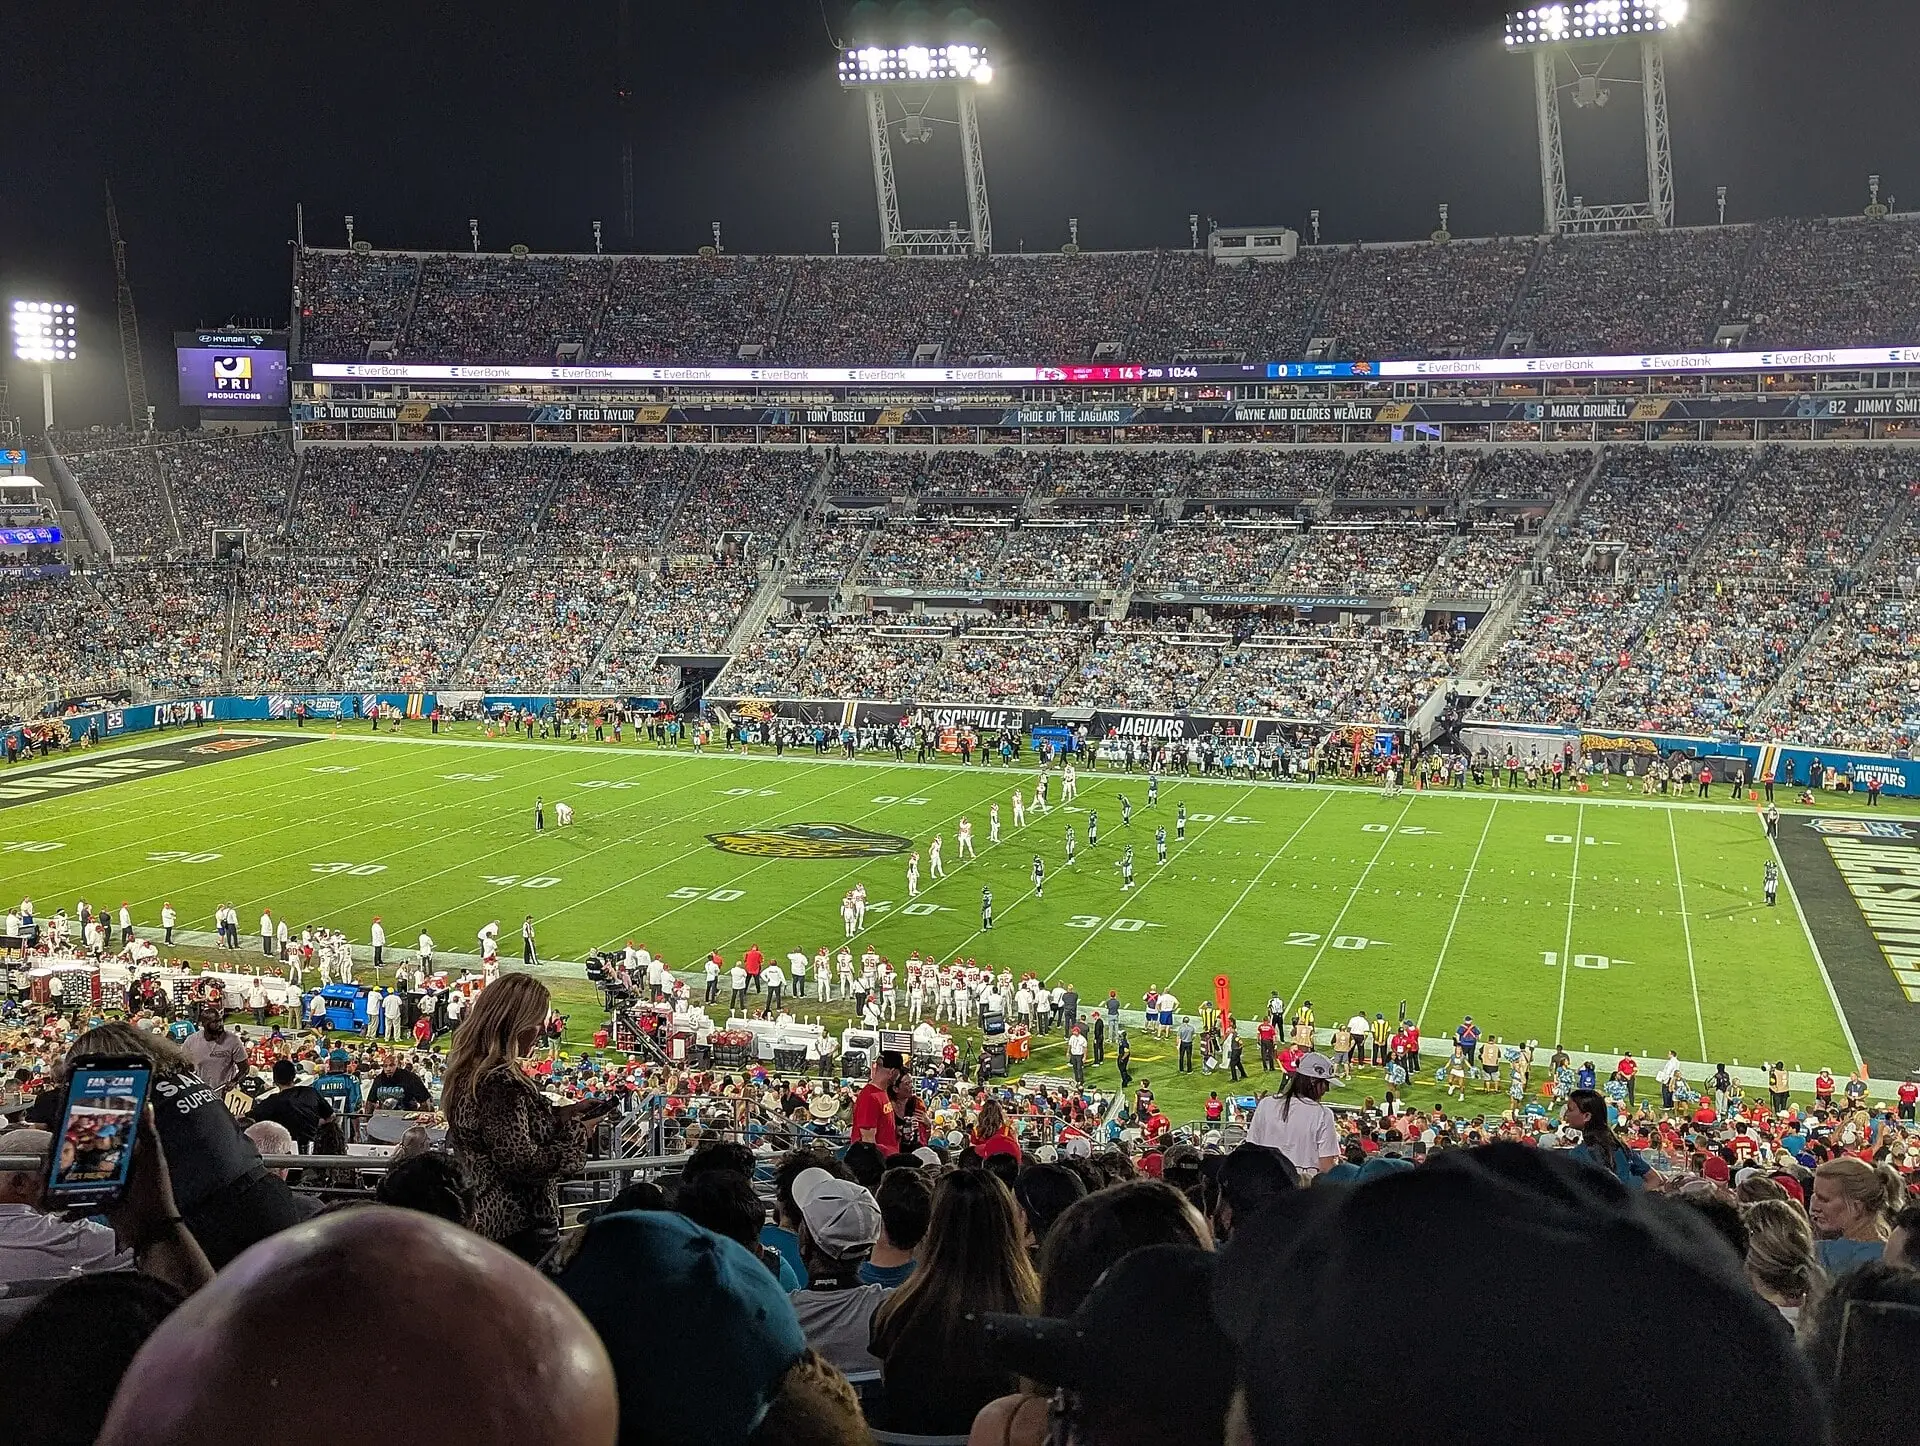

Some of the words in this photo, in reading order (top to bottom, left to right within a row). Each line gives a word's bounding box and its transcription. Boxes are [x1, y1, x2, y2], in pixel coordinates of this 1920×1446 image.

[1539, 359, 1594, 370] EverBank
[1653, 356, 1712, 368] EverBank
[1775, 352, 1836, 366] EverBank
[358, 366, 408, 378] EverBank
[1147, 368, 1162, 378] 2ND
[1168, 367, 1198, 378] 10:44
[1278, 364, 1288, 377] 0
[1428, 361, 1481, 373] EverBank
[461, 368, 510, 379] EverBank
[562, 369, 612, 380] EverBank
[664, 370, 711, 380] EverBank
[762, 370, 809, 380] EverBank
[858, 371, 906, 381] EverBank
[955, 370, 1003, 381] EverBank
[1118, 367, 1134, 379] 14
[218, 378, 249, 390] PRI
[1536, 405, 1544, 417] 8
[1551, 404, 1580, 418] MARK
[1583, 404, 1627, 417] BRUNELL
[1829, 400, 1846, 413] 82
[1853, 399, 1892, 413] JIMMY
[313, 407, 327, 418] HC
[329, 407, 349, 419] TOM
[352, 407, 397, 419] COUGHLIN
[559, 409, 572, 420] 28
[578, 409, 600, 420] FRED
[603, 409, 635, 421] TAYLOR
[790, 411, 800, 422] 71
[807, 411, 829, 422] TONY
[832, 411, 865, 422] BOSELLI
[1017, 410, 1044, 422] PRIDE
[1046, 410, 1059, 422] OF
[1060, 410, 1076, 422] THE
[1078, 410, 1120, 422] JAGUARS
[1235, 408, 1267, 421] WAYNE
[1268, 408, 1287, 420] AND
[1290, 407, 1331, 420] DELORES
[1334, 407, 1372, 420] WEAVER
[926, 589, 998, 597] Gallagher
[1001, 590, 1083, 598] INSURANCE
[1199, 594, 1276, 603] Gallagher
[1279, 596, 1369, 605] INSURANCE
[316, 701, 341, 709] CATCH
[1115, 716, 1185, 738] JAGUARS
[1855, 763, 1900, 774] JACKSONVILLE
[871, 795, 932, 806] 50
[1361, 824, 1426, 835] 20
[666, 886, 747, 902] 50
[866, 900, 941, 916] 40
[1064, 914, 1138, 932] 30
[1284, 931, 1368, 950] 20
[864, 958, 875, 968] 95
[1538, 950, 1609, 970] 10
[924, 969, 935, 978] 23
[882, 975, 891, 985] 51
[940, 977, 950, 987] 96
[256, 1053, 265, 1064] 15
[1736, 1148, 1752, 1160] 15
